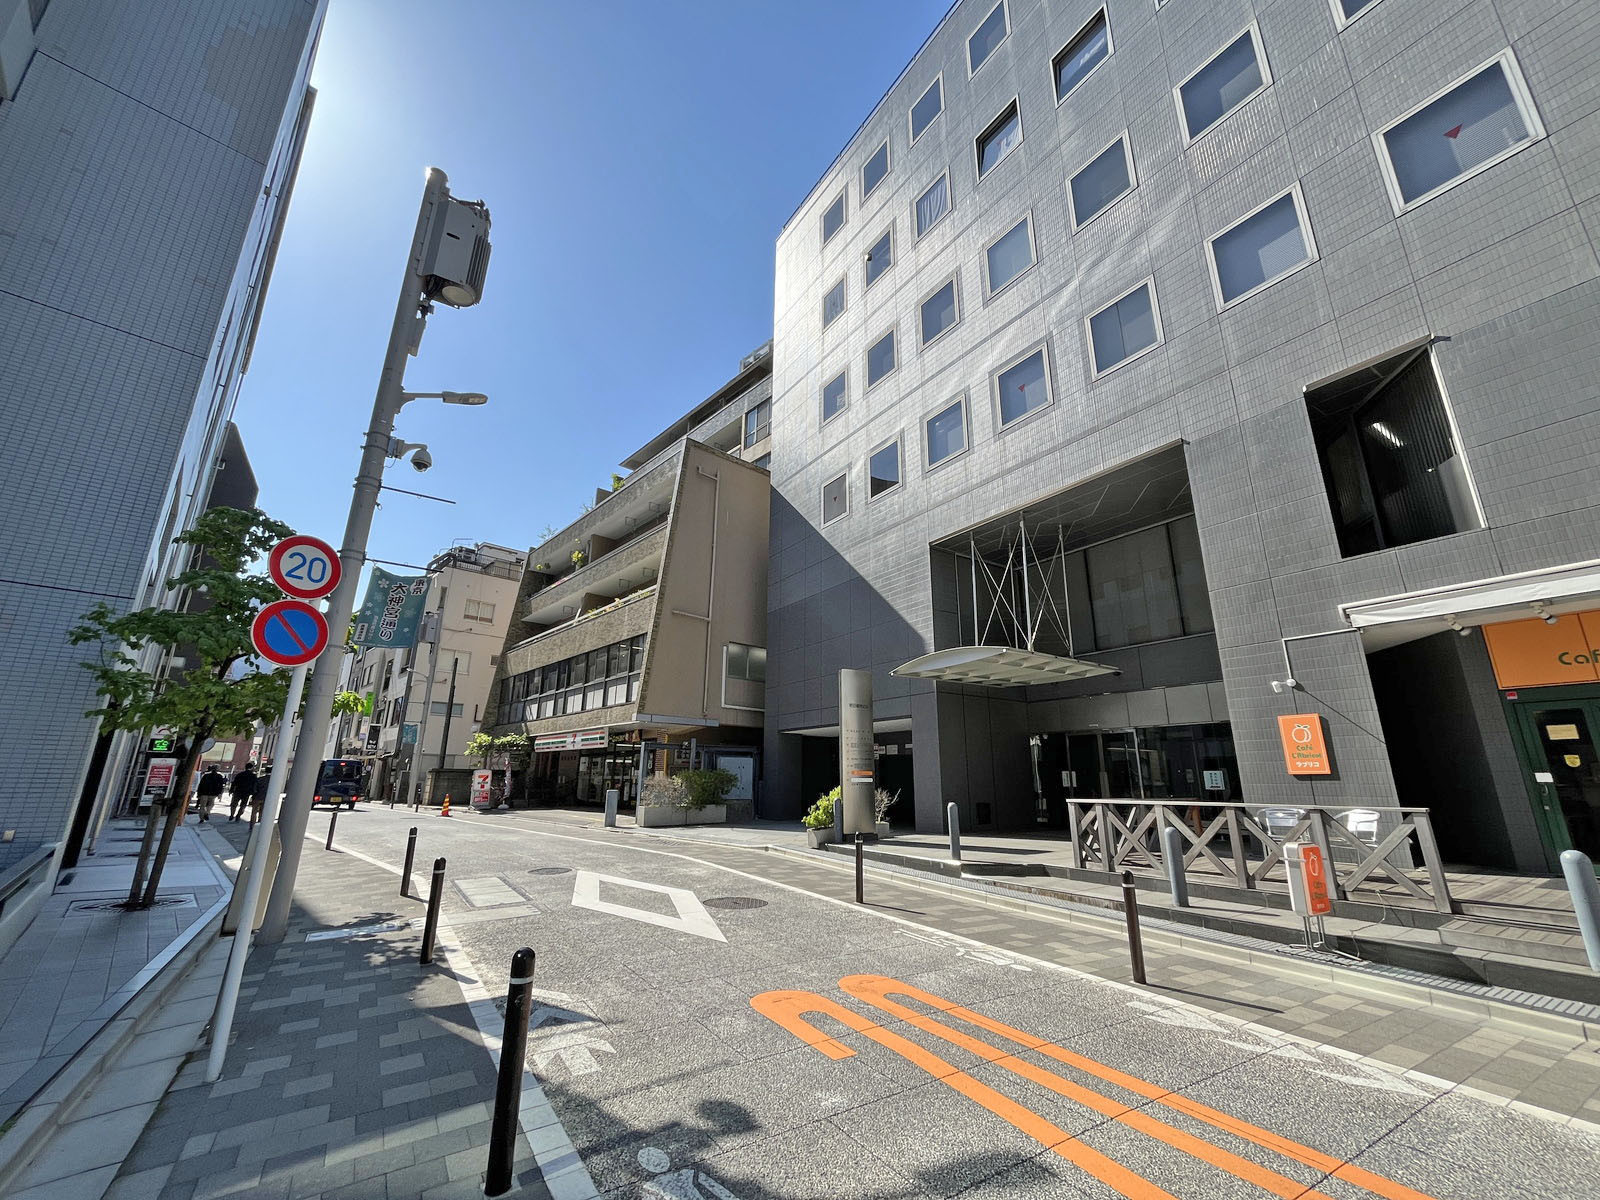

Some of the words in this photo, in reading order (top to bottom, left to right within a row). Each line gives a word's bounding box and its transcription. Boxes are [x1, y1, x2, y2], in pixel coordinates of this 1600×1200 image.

[285, 551, 327, 584] 20
[411, 578, 426, 595] 東京
[379, 582, 408, 641] 大神宮通り
